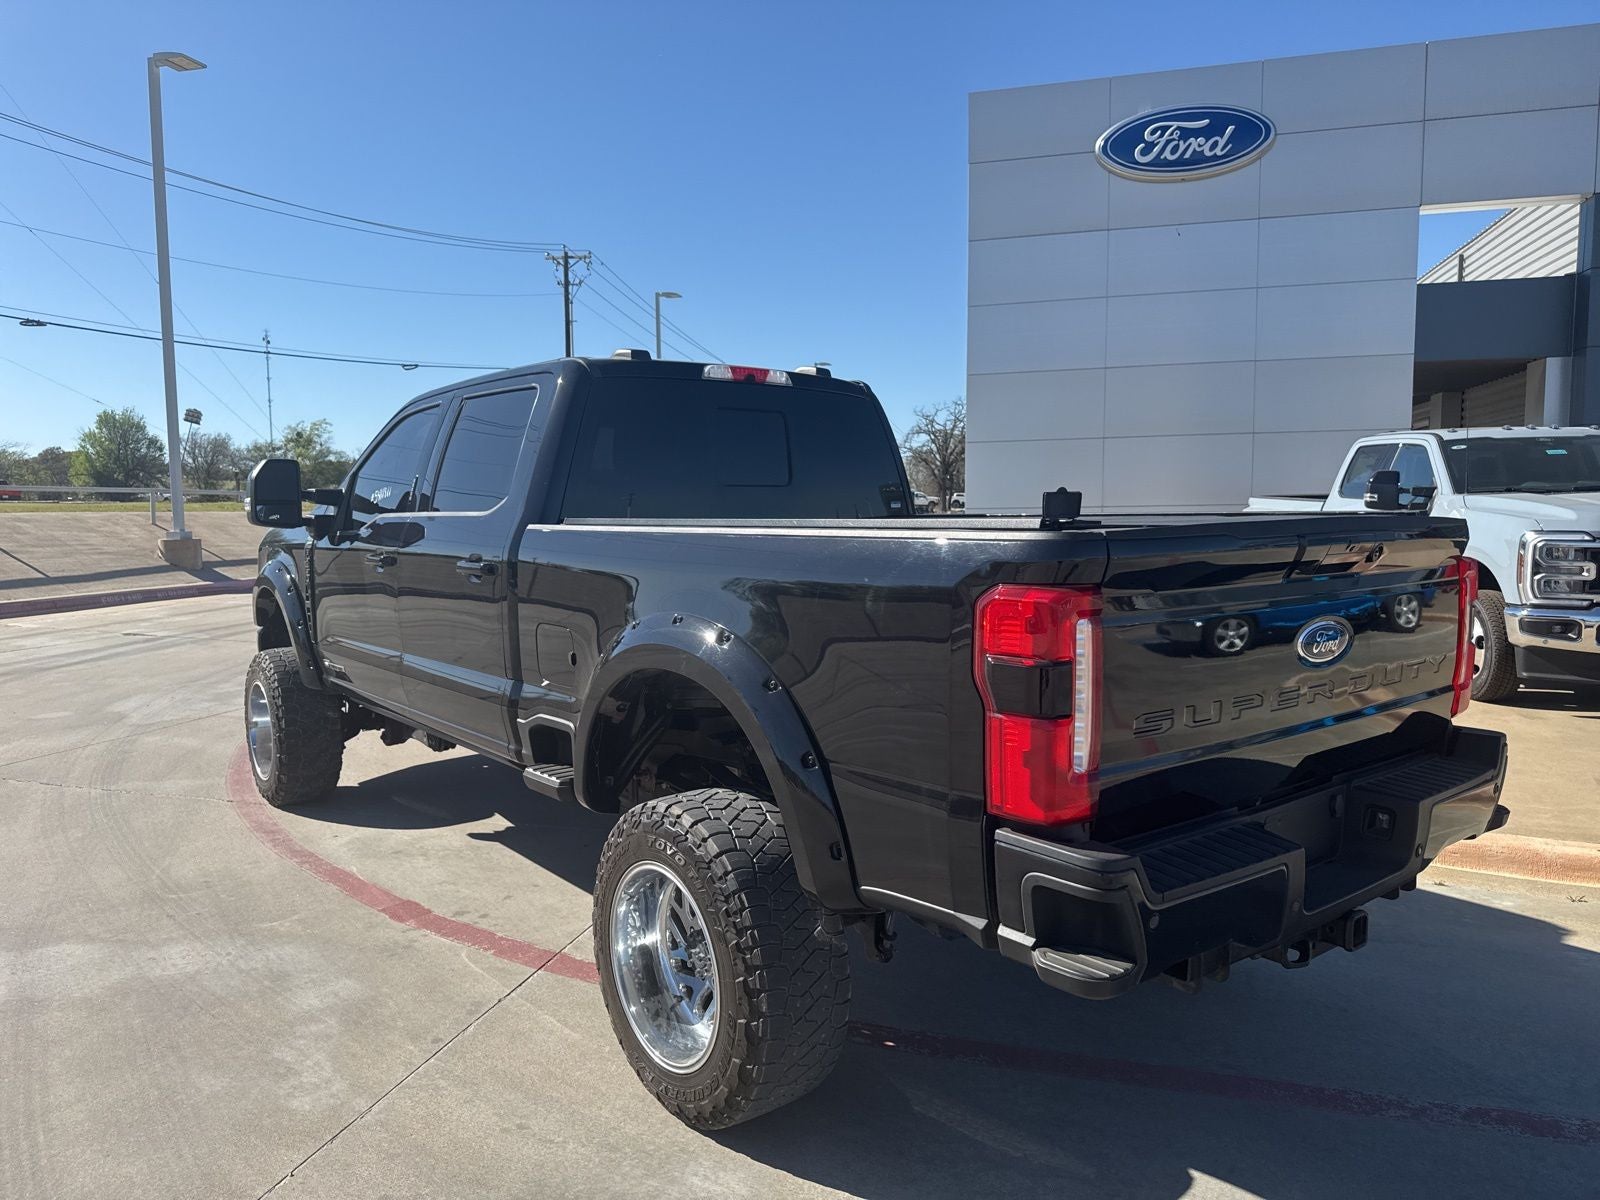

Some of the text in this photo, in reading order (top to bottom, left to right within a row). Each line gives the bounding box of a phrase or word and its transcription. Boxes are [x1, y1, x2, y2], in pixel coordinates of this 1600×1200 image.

[1134, 119, 1235, 163] Ford
[1312, 630, 1341, 654] Ford
[1133, 653, 1448, 739] SUPER DUTY
